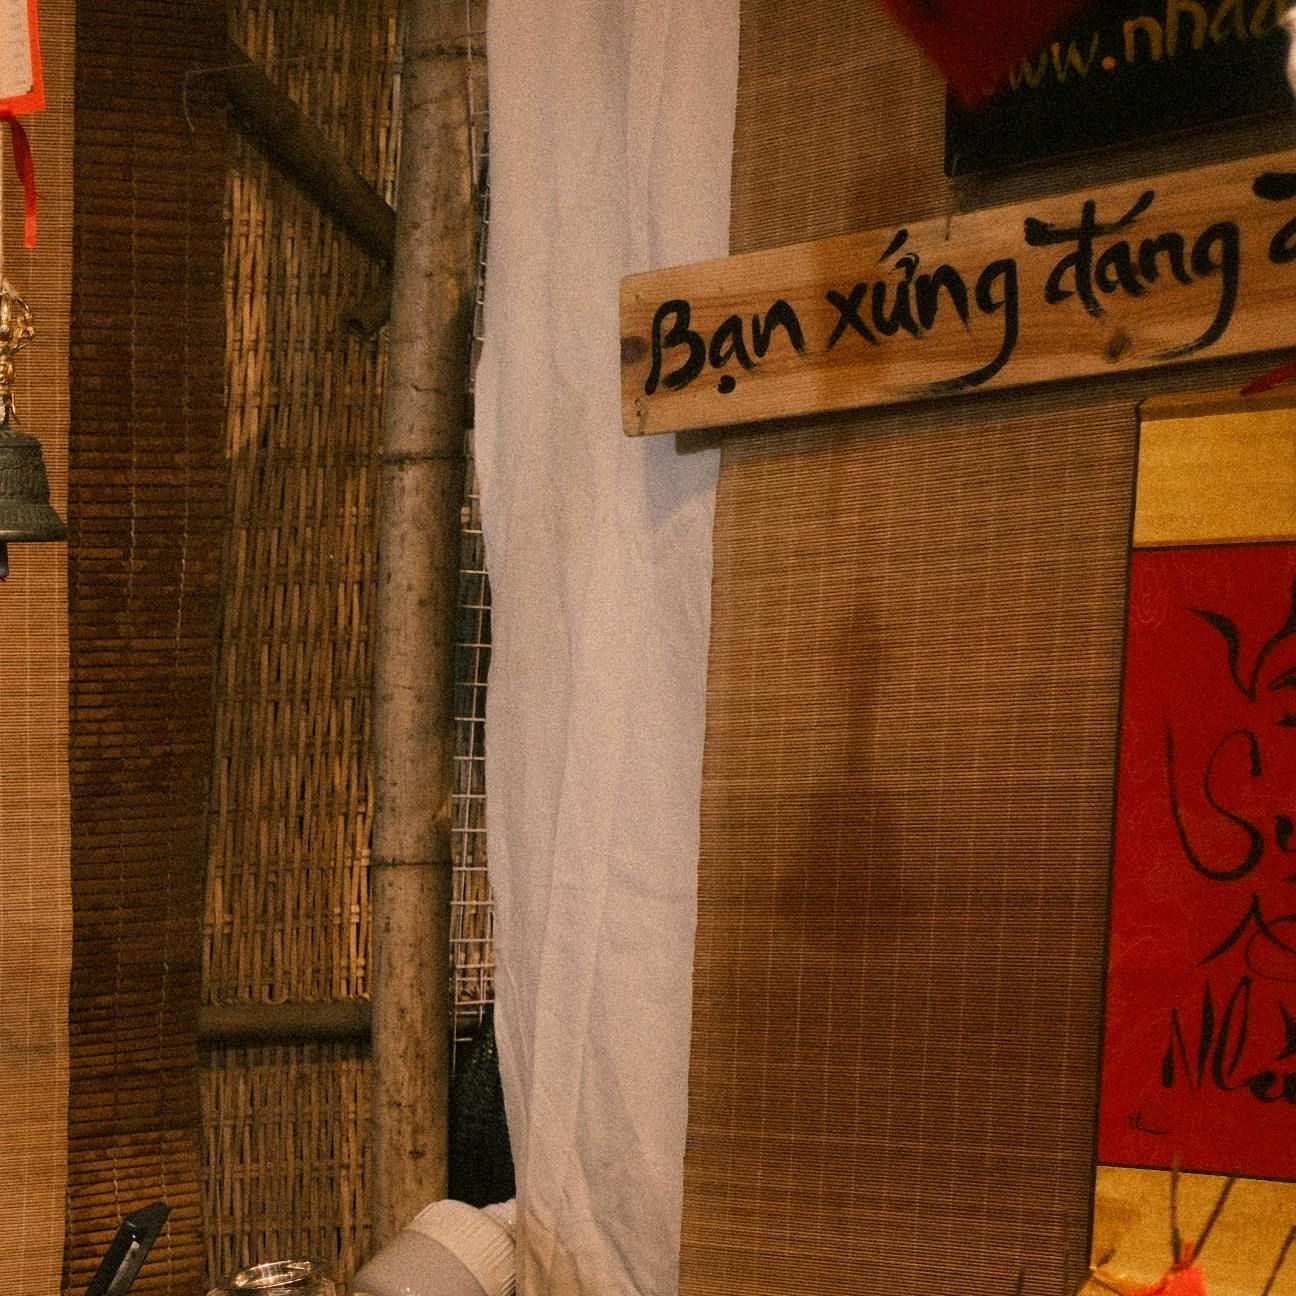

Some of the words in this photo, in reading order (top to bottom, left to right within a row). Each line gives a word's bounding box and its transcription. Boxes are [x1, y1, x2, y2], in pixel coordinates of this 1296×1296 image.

[644, 298, 808, 396] Bạn
[827, 230, 1019, 394] xứng
[1024, 191, 1240, 361] đáng
